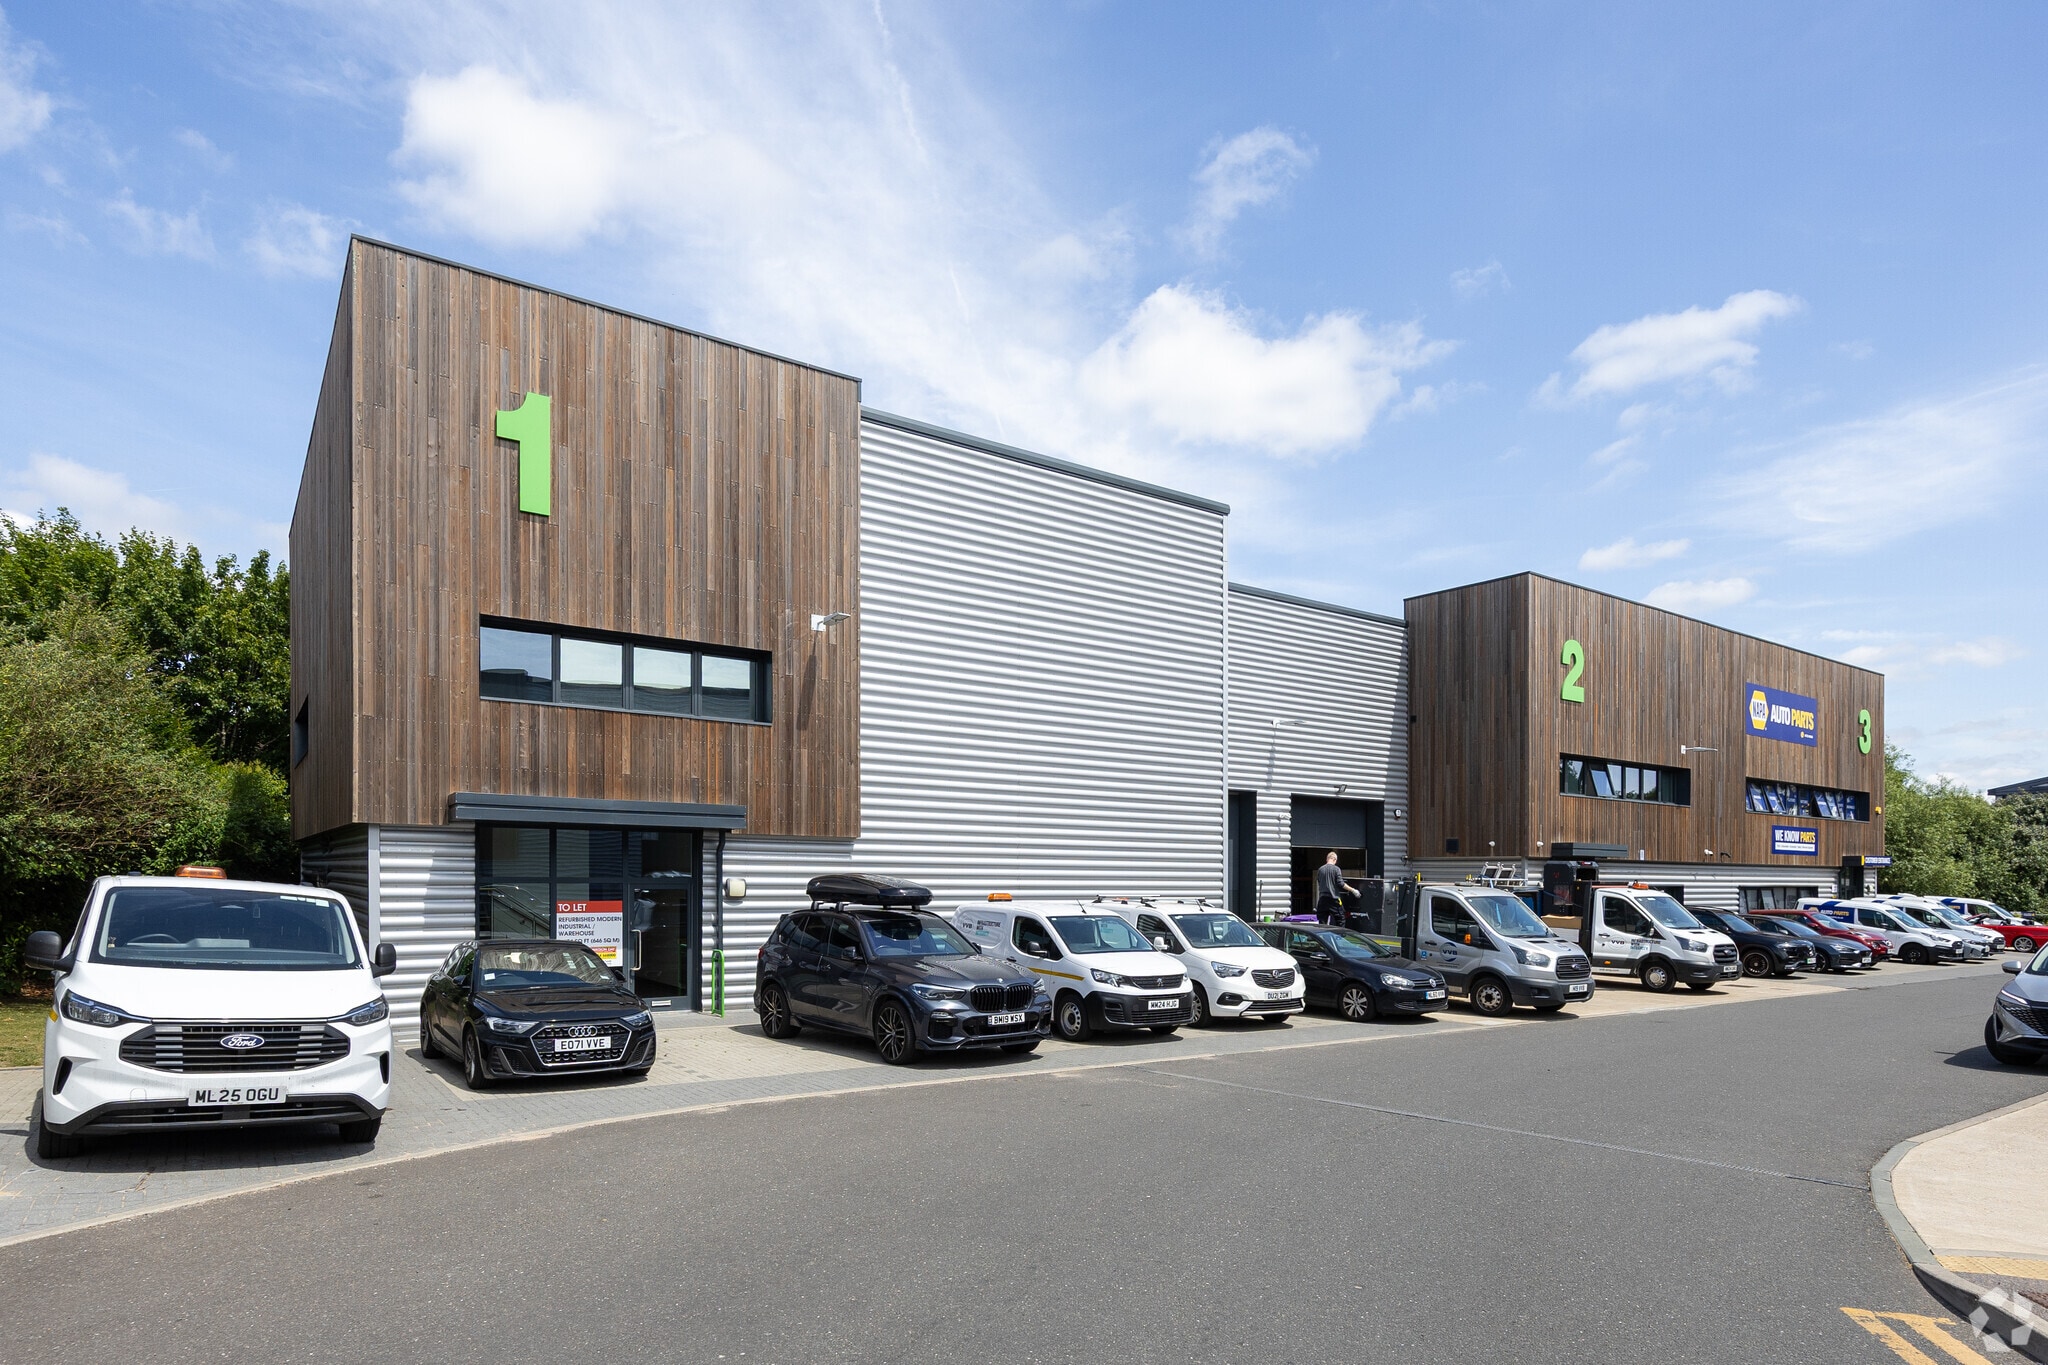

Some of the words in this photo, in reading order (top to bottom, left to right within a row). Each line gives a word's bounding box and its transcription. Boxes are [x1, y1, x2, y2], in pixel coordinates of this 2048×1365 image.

[495, 391, 551, 517] 1
[1561, 639, 1585, 703] 2
[1752, 700, 1766, 720] NAPA
[1770, 704, 1791, 726] AUTO
[1791, 708, 1815, 731] PARTS
[1858, 709, 1872, 754] 3
[1774, 829, 1784, 842] WE
[1784, 830, 1800, 843] KNOW
[1800, 831, 1816, 844] PARTS
[994, 1015, 1009, 1024] BM19
[1010, 1014, 1023, 1022] WSX
[228, 1036, 257, 1047] Ford
[587, 1039, 605, 1048] VVE
[195, 1089, 241, 1103] ML25
[246, 1088, 279, 1101] OGU
